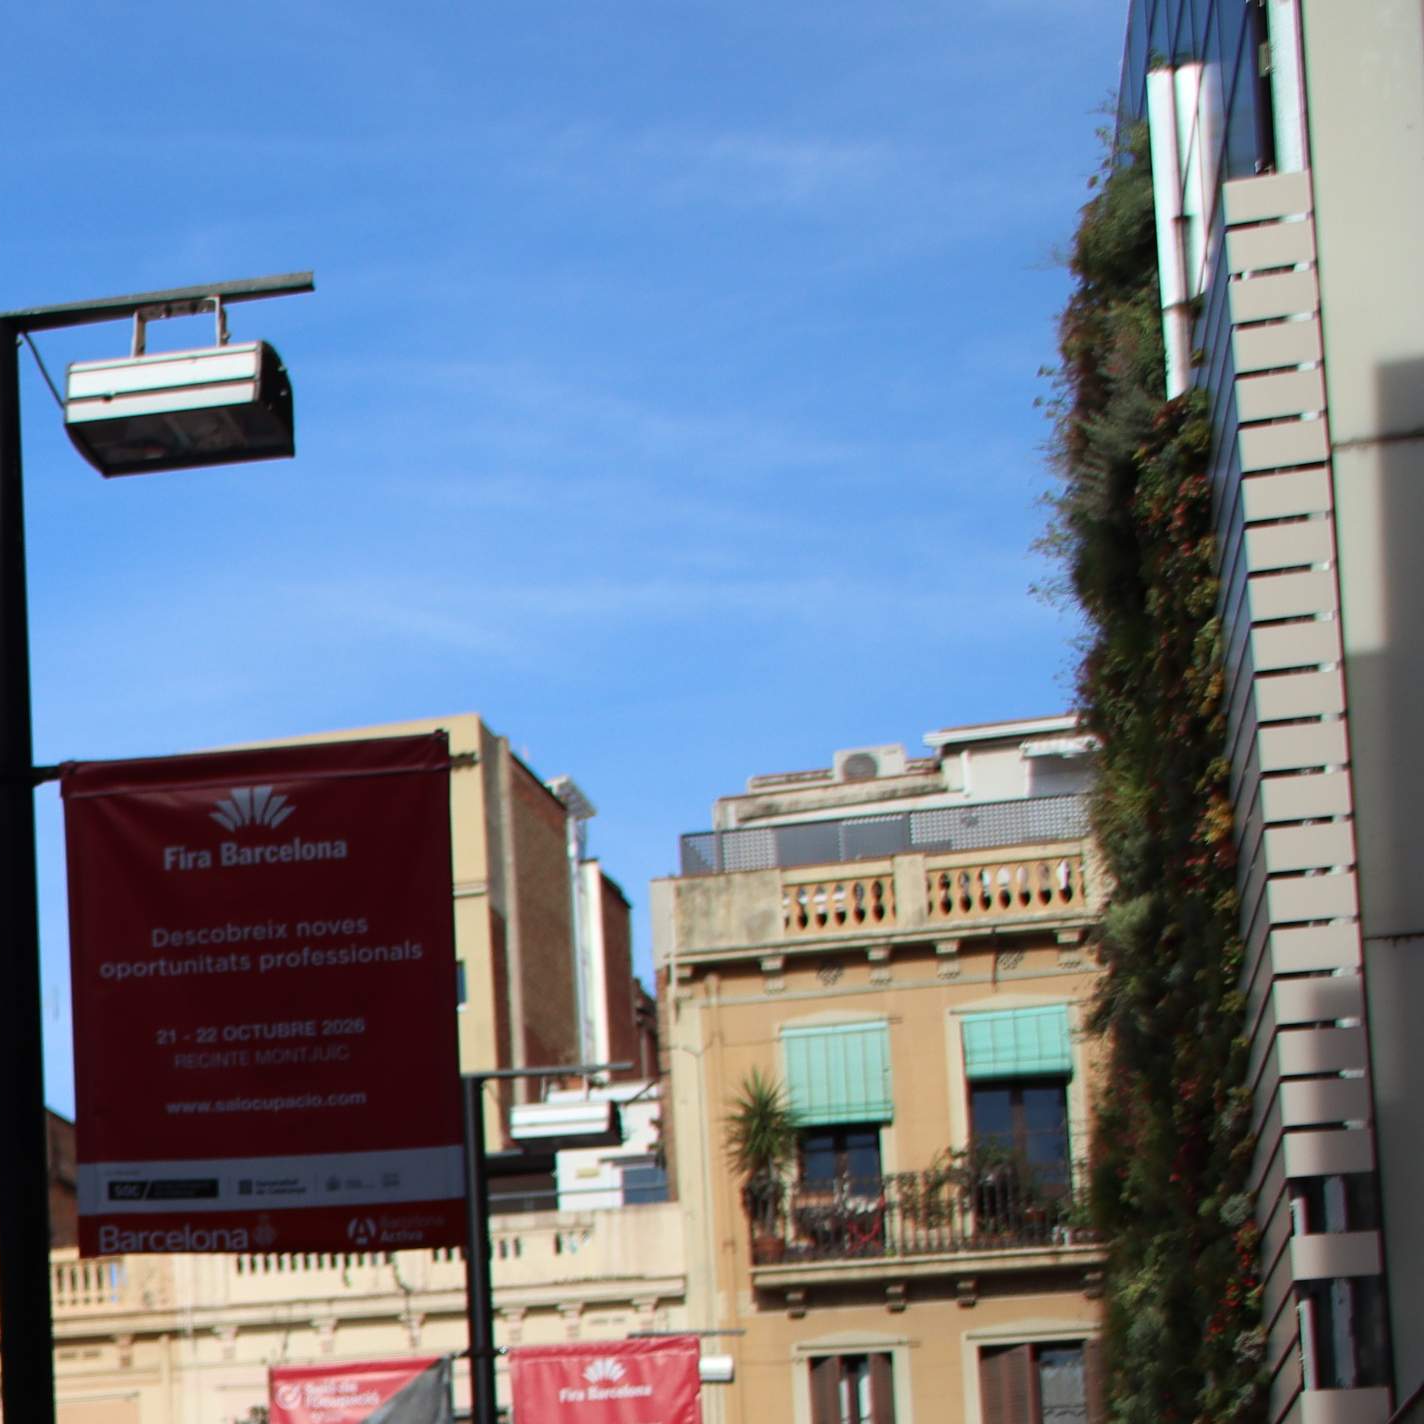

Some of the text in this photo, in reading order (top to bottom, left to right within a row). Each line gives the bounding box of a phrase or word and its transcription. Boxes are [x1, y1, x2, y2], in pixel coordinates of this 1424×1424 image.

[163, 836, 349, 873] Fira Barcelona
[151, 916, 369, 950] Descobreix noves
[98, 939, 424, 982] oportunitats professionals
[155, 1027, 177, 1046] 21
[195, 1025, 219, 1044] 22
[222, 1020, 318, 1042] OCTUBRE
[173, 1050, 251, 1070] RECINTE
[97, 1221, 251, 1254] Barcelona
